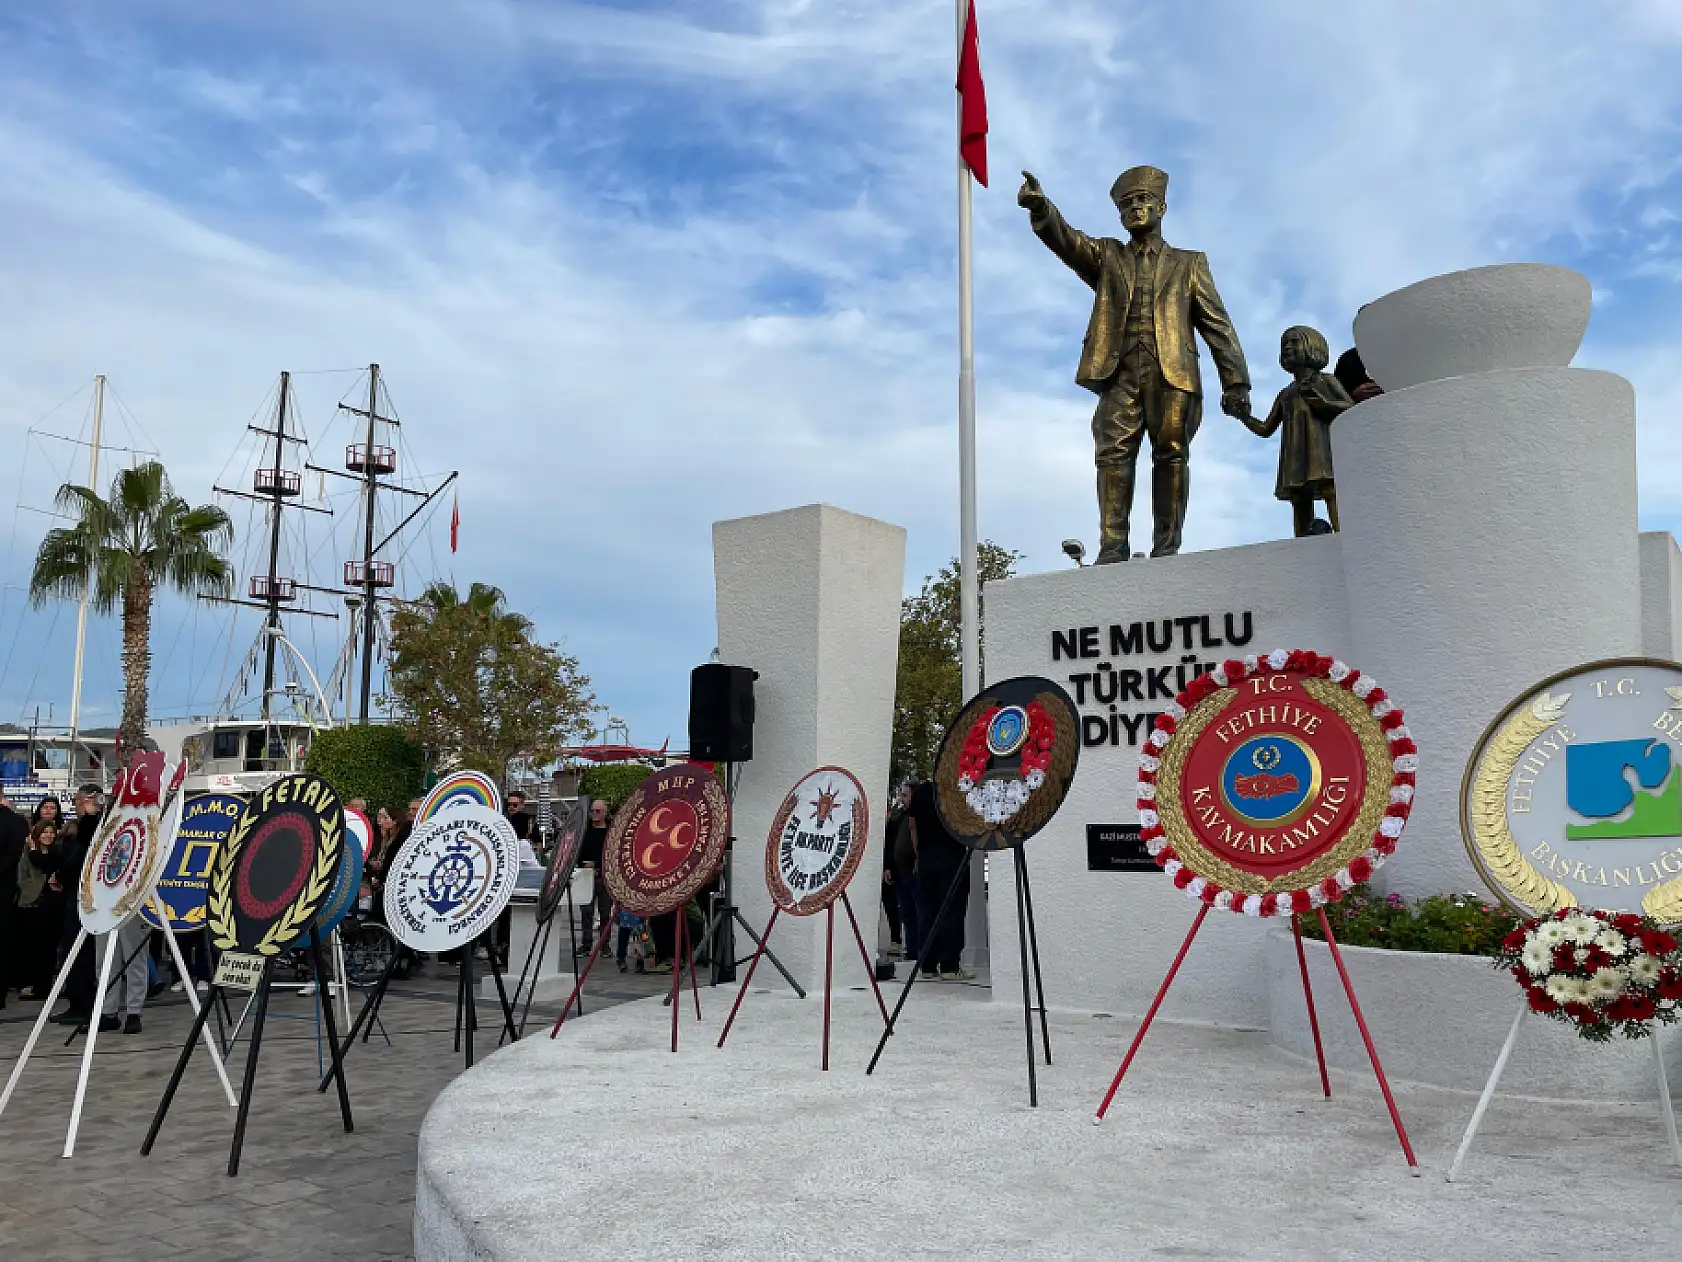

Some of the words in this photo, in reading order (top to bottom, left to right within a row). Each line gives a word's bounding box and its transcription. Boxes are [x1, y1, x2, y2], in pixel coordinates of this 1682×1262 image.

[1052, 626, 1100, 661] NE
[1109, 611, 1253, 656] MUTLU
[1249, 675, 1292, 695] T.C.
[1216, 702, 1322, 743] FETHİYE
[1512, 724, 1577, 815] FETHİYE
[1653, 711, 1682, 746] BE
[262, 777, 335, 813] FETAV
[1192, 776, 1349, 854] KAYMAKAMLIĞI
